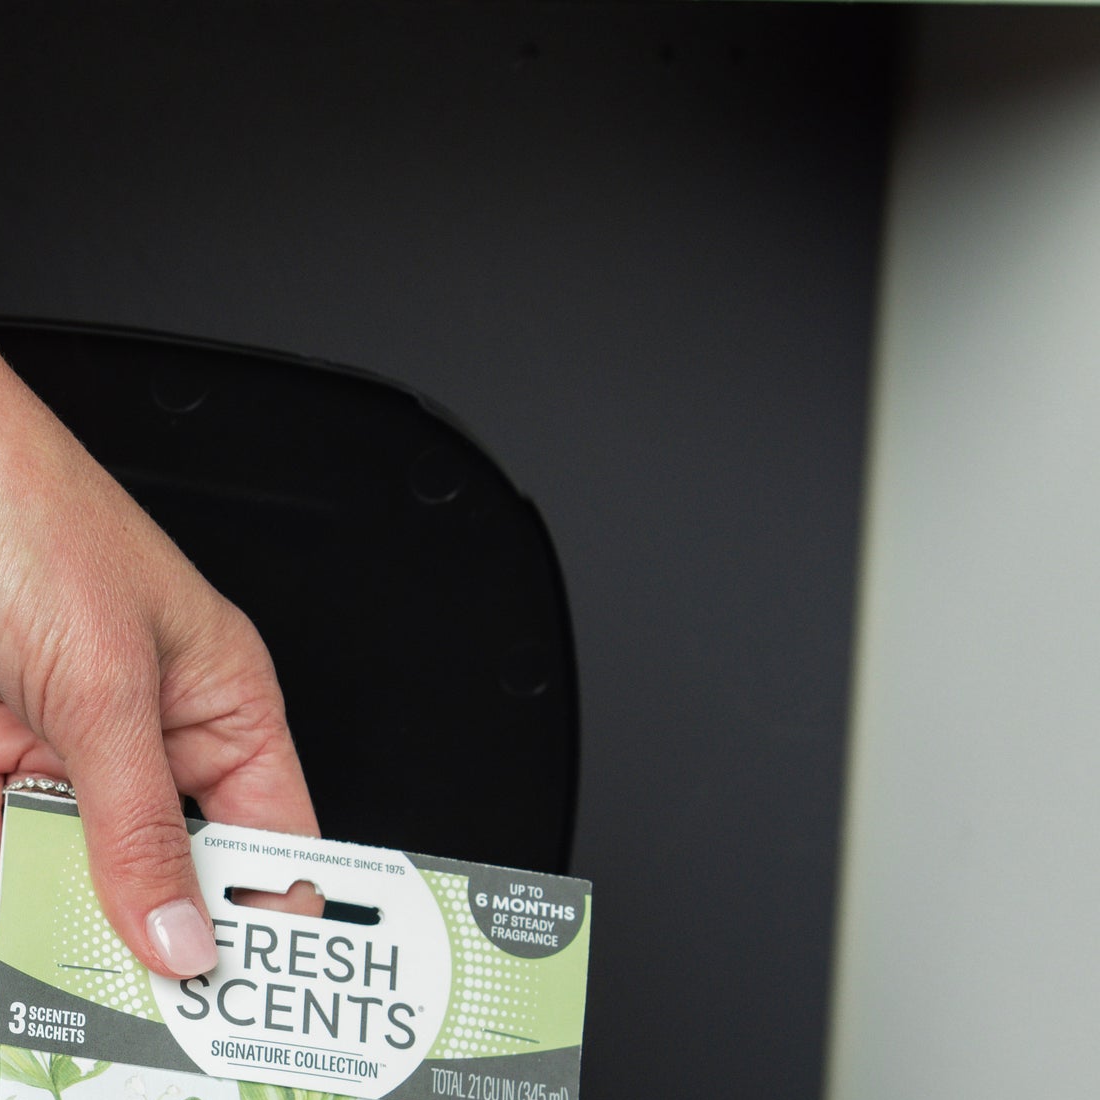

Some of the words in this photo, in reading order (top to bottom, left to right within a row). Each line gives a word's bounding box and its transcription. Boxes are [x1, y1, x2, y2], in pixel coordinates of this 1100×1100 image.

[204, 836, 247, 852] EXPERTS
[249, 843, 260, 854] IN
[262, 845, 292, 859] HOME
[293, 849, 352, 867] FRAGRANCE
[354, 858, 384, 872] SINCE
[385, 863, 406, 876] 1975
[509, 883, 526, 896] UP
[527, 885, 544, 899] TO
[475, 892, 488, 908] 6
[492, 894, 576, 921] MONTHS
[490, 926, 559, 948] FRAGRANCE
[492, 912, 509, 925] OF
[510, 915, 555, 933] STEADY
[8, 1001, 28, 1035] 3
[28, 1005, 86, 1027] SCENTED
[175, 973, 417, 1051] SCENTS
[27, 1022, 85, 1044] SACHETS
[210, 1039, 292, 1066] SIGNATURE
[294, 1050, 379, 1079] COLLECTION
[431, 1067, 466, 1099] TOTAL
[467, 1073, 481, 1100] 21
